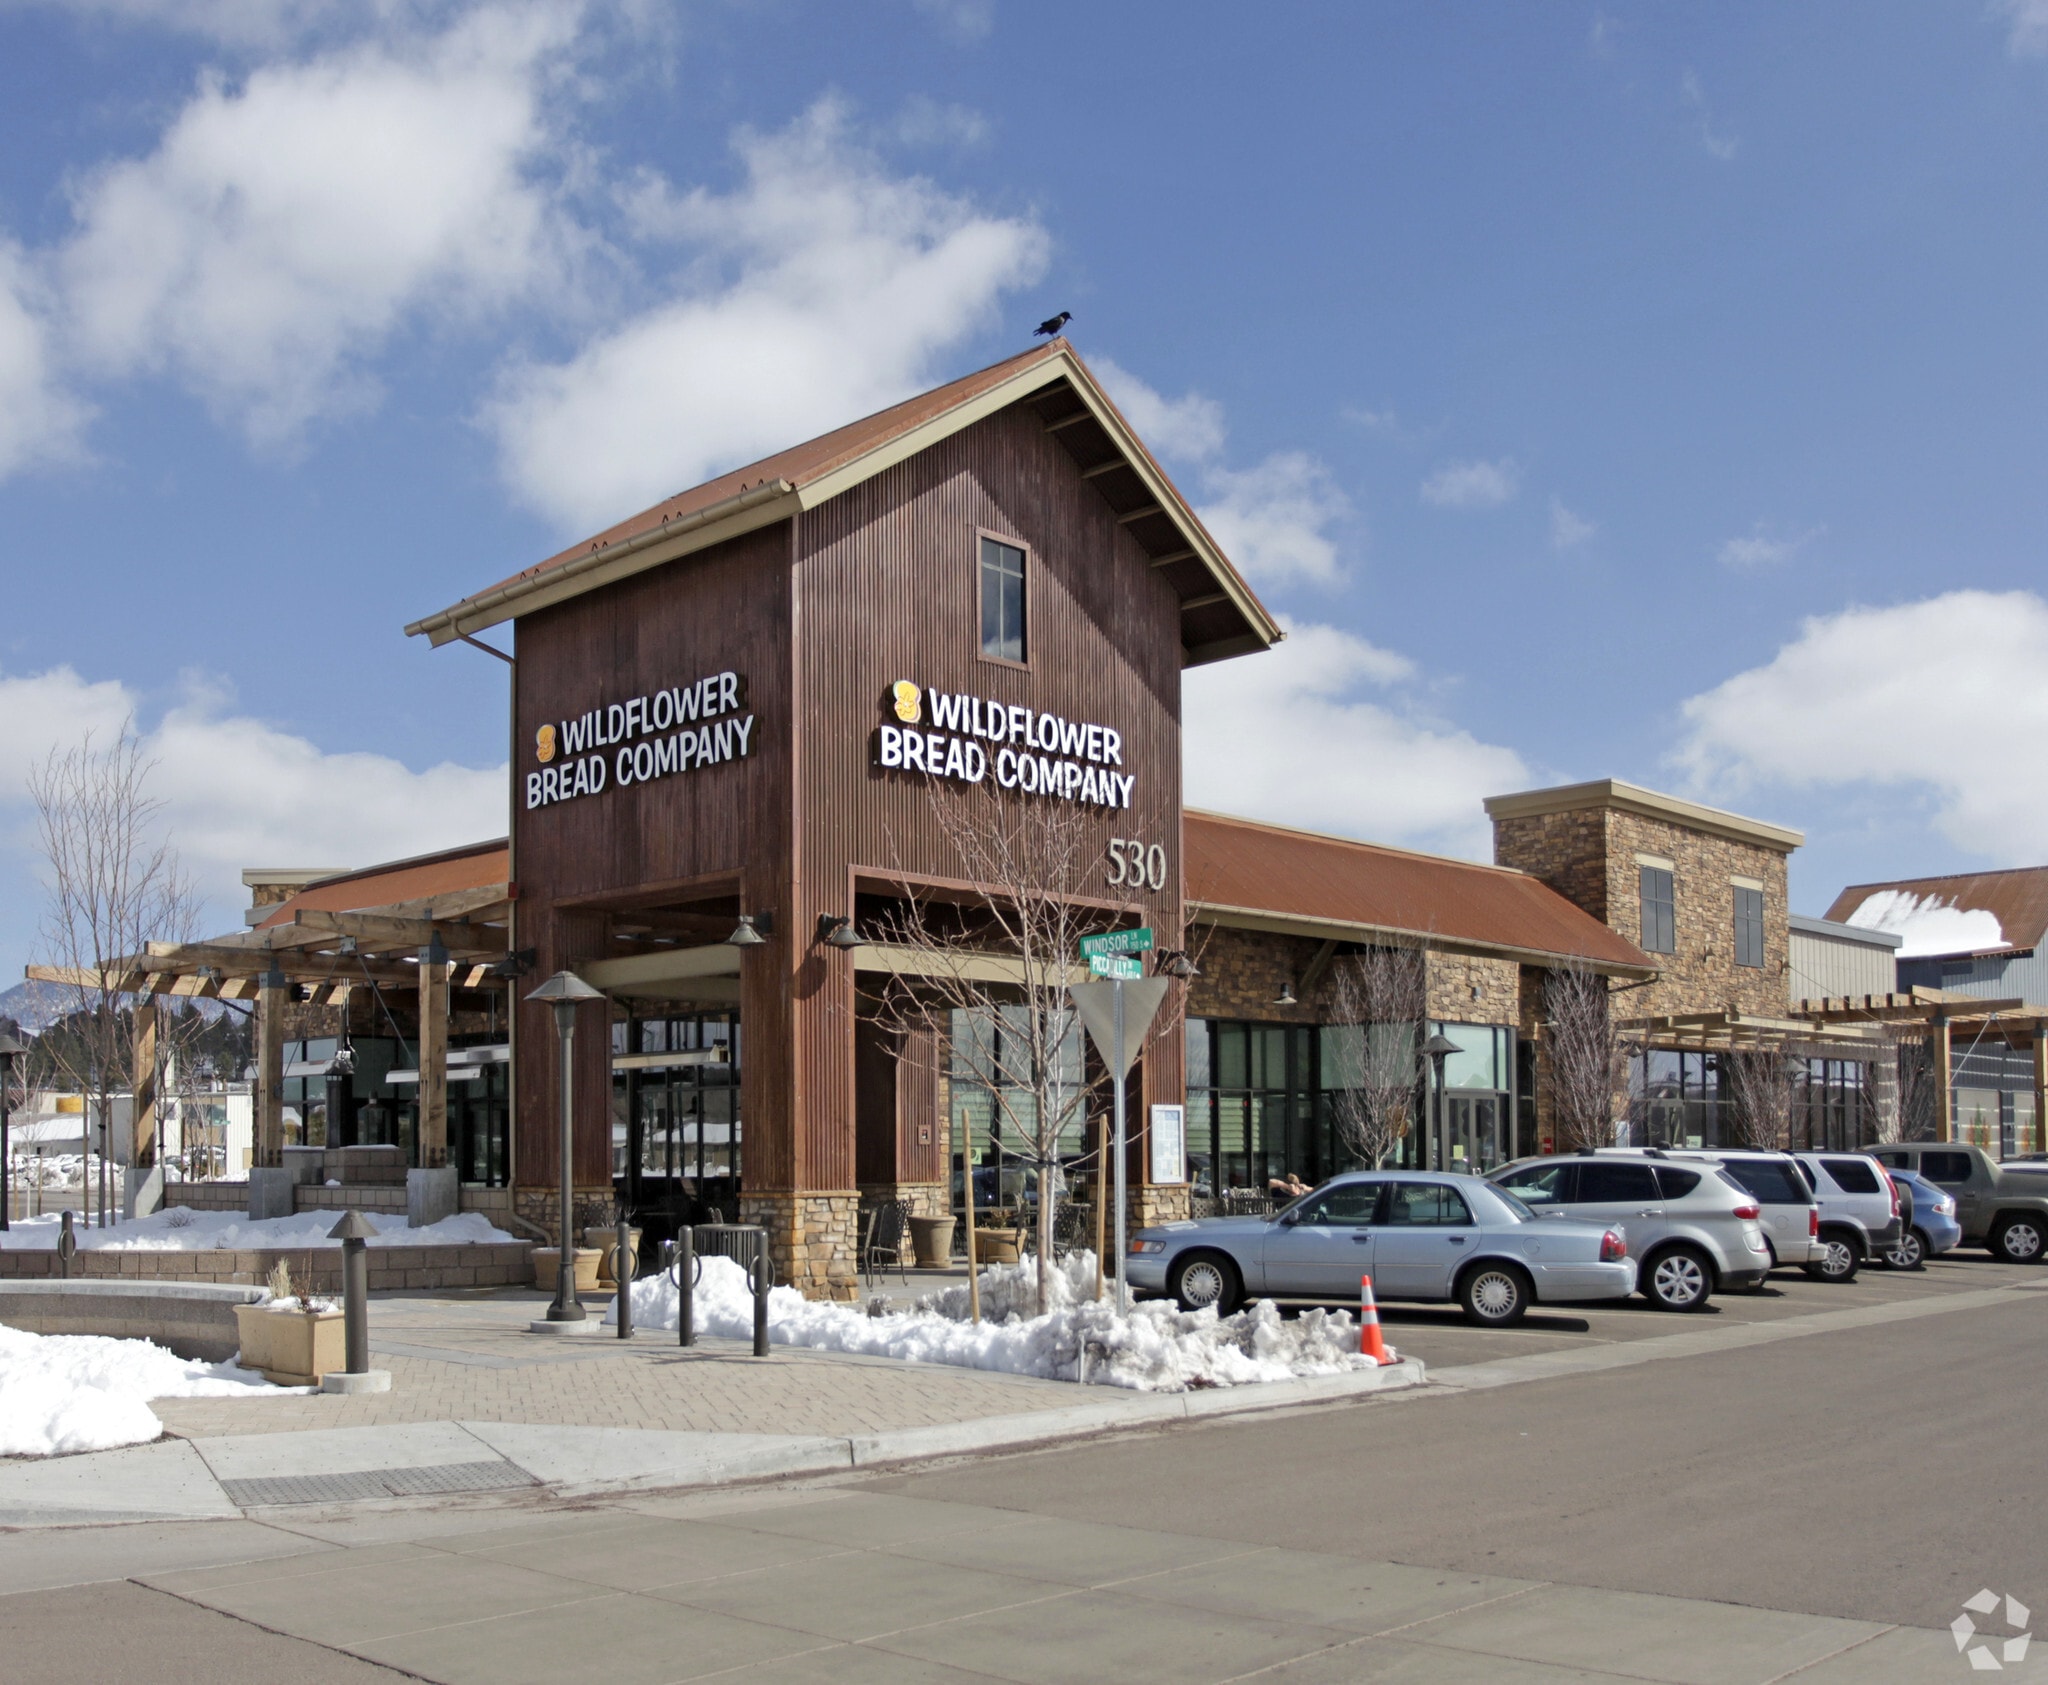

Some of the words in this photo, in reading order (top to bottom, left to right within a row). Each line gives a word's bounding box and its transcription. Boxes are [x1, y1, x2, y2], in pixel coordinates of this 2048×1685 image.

[561, 671, 739, 755] WILDFLOWER
[928, 687, 1122, 765] WILDFLOWER
[527, 755, 606, 809] BREAD
[616, 714, 754, 786] COMPANY
[880, 725, 986, 783] BREAD
[996, 748, 1135, 809] COMPANY
[1107, 837, 1167, 891] 530
[1083, 934, 1129, 955] WINDSOR
